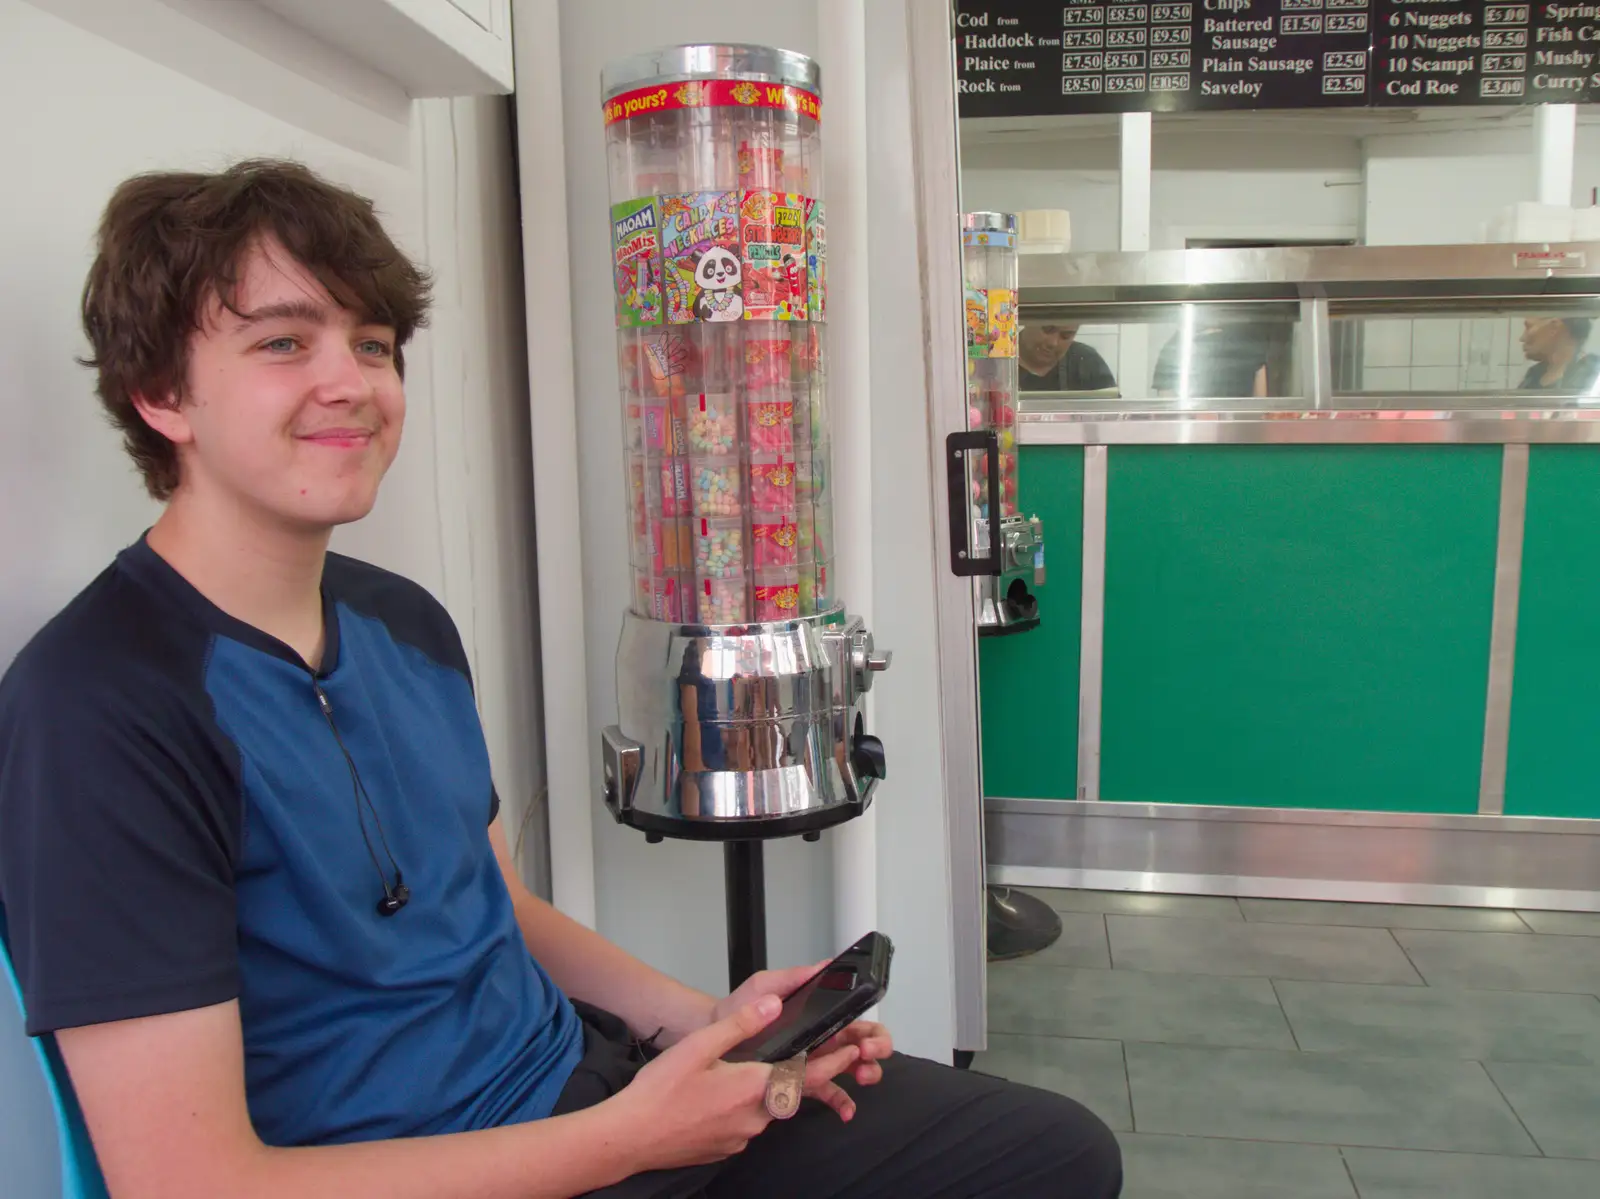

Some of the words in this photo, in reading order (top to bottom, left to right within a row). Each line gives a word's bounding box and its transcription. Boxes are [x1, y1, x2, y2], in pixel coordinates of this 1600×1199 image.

[957, 12, 988, 27] Cod
[997, 17, 1019, 26] from
[1066, 9, 1101, 22] £7.50
[1109, 7, 1145, 21] £8.50
[1154, 6, 1190, 19] £9.50
[1203, 16, 1273, 33] Battered
[1283, 17, 1321, 31] £1.50
[1328, 16, 1366, 30] £2.50
[1389, 12, 1400, 26] 6
[1404, 11, 1472, 30] Nuggets
[965, 32, 1034, 49] Haddock
[1038, 37, 1060, 46] from
[1066, 32, 1101, 45] £7.50
[1109, 30, 1144, 44] £8.50
[1153, 29, 1189, 43] £9.50
[1536, 26, 1573, 42] Fish
[1211, 35, 1277, 52] Sausage
[1389, 34, 1408, 50] 10
[1412, 34, 1480, 52] Nuggets
[964, 56, 1010, 71] Plaice
[1014, 60, 1036, 69] from
[1065, 55, 1100, 68] £7.50
[1152, 52, 1188, 66] £9.50
[1202, 57, 1243, 73] Plain
[1248, 56, 1314, 74] Sausage
[1326, 54, 1364, 68] £2.50
[1389, 57, 1408, 73] 10
[1411, 56, 1475, 75] Scampi
[1533, 49, 1595, 69] Mushy
[958, 78, 996, 94] Rock
[1000, 83, 1021, 92] from
[1065, 78, 1100, 91] £8.50
[1108, 76, 1143, 90] £9.50
[1200, 79, 1263, 98] Saveloy
[1325, 77, 1363, 91] £2.50
[1386, 80, 1421, 95] Cod
[1425, 80, 1459, 95] Roe
[1532, 73, 1588, 92] Curry
[624, 89, 668, 118] yours?
[616, 208, 654, 241] MAOAM
[675, 202, 716, 233] CANDY
[668, 216, 735, 257] NECKLACES
[745, 224, 802, 245] STRWBERRY
